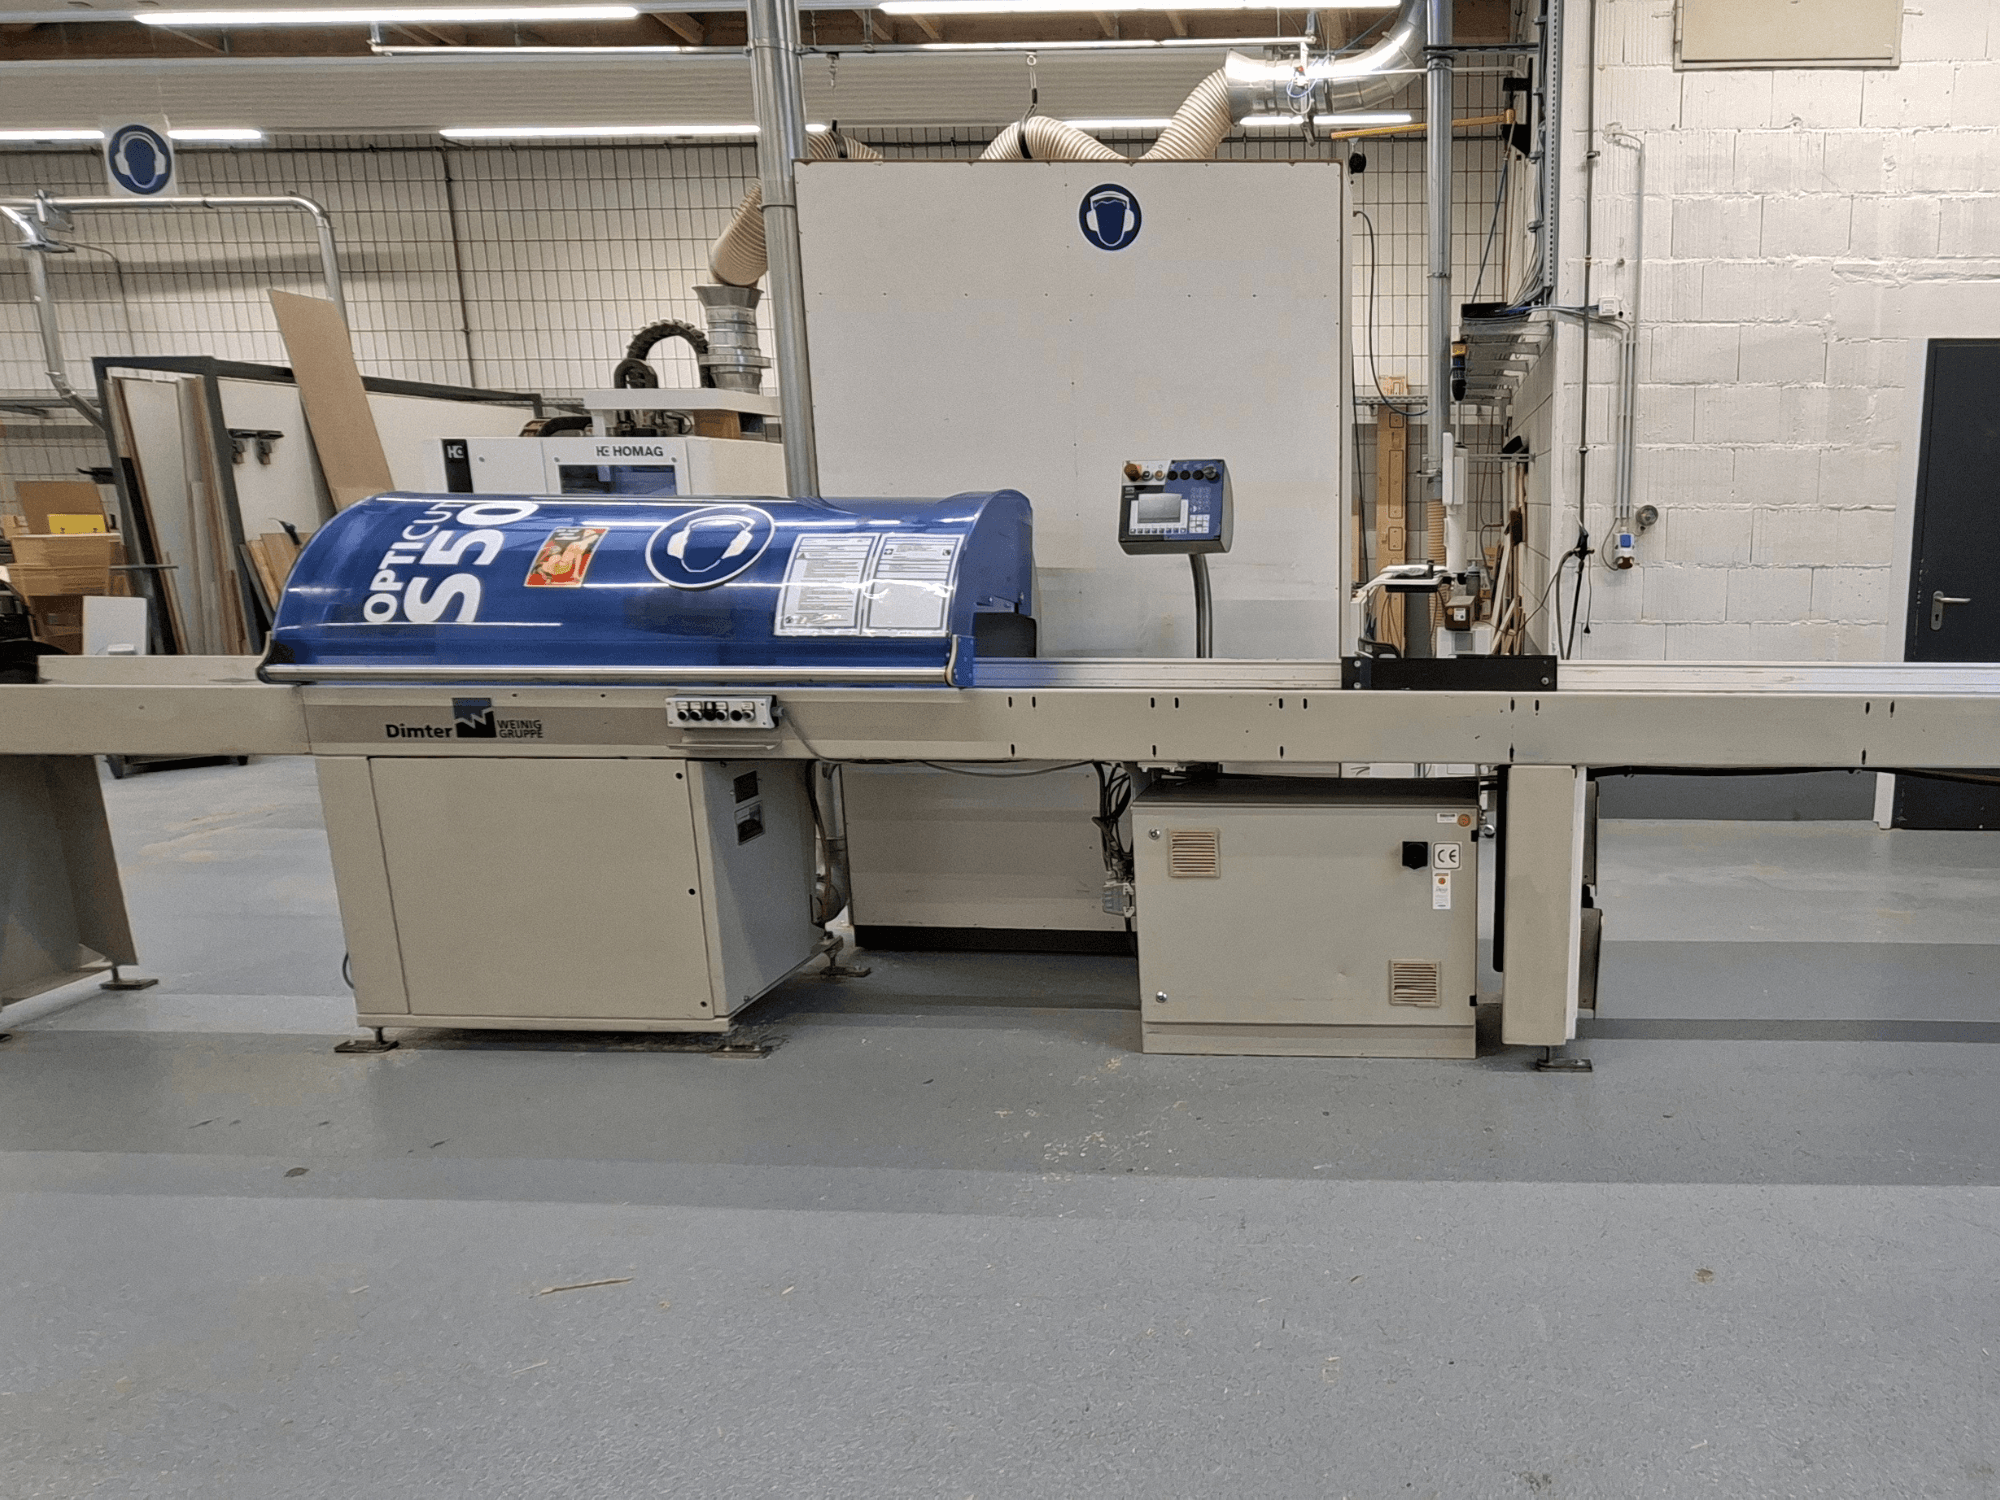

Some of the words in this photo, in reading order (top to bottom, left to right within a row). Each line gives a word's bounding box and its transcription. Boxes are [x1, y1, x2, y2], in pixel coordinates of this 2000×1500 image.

[612, 445, 664, 457] HOMAG
[363, 502, 467, 623] OPTICUT
[403, 501, 540, 623] S50
[385, 723, 453, 739] Dimter
[497, 719, 542, 730] WEINIG
[499, 728, 544, 739] GRUPPE
[1437, 849, 1457, 864] CE
